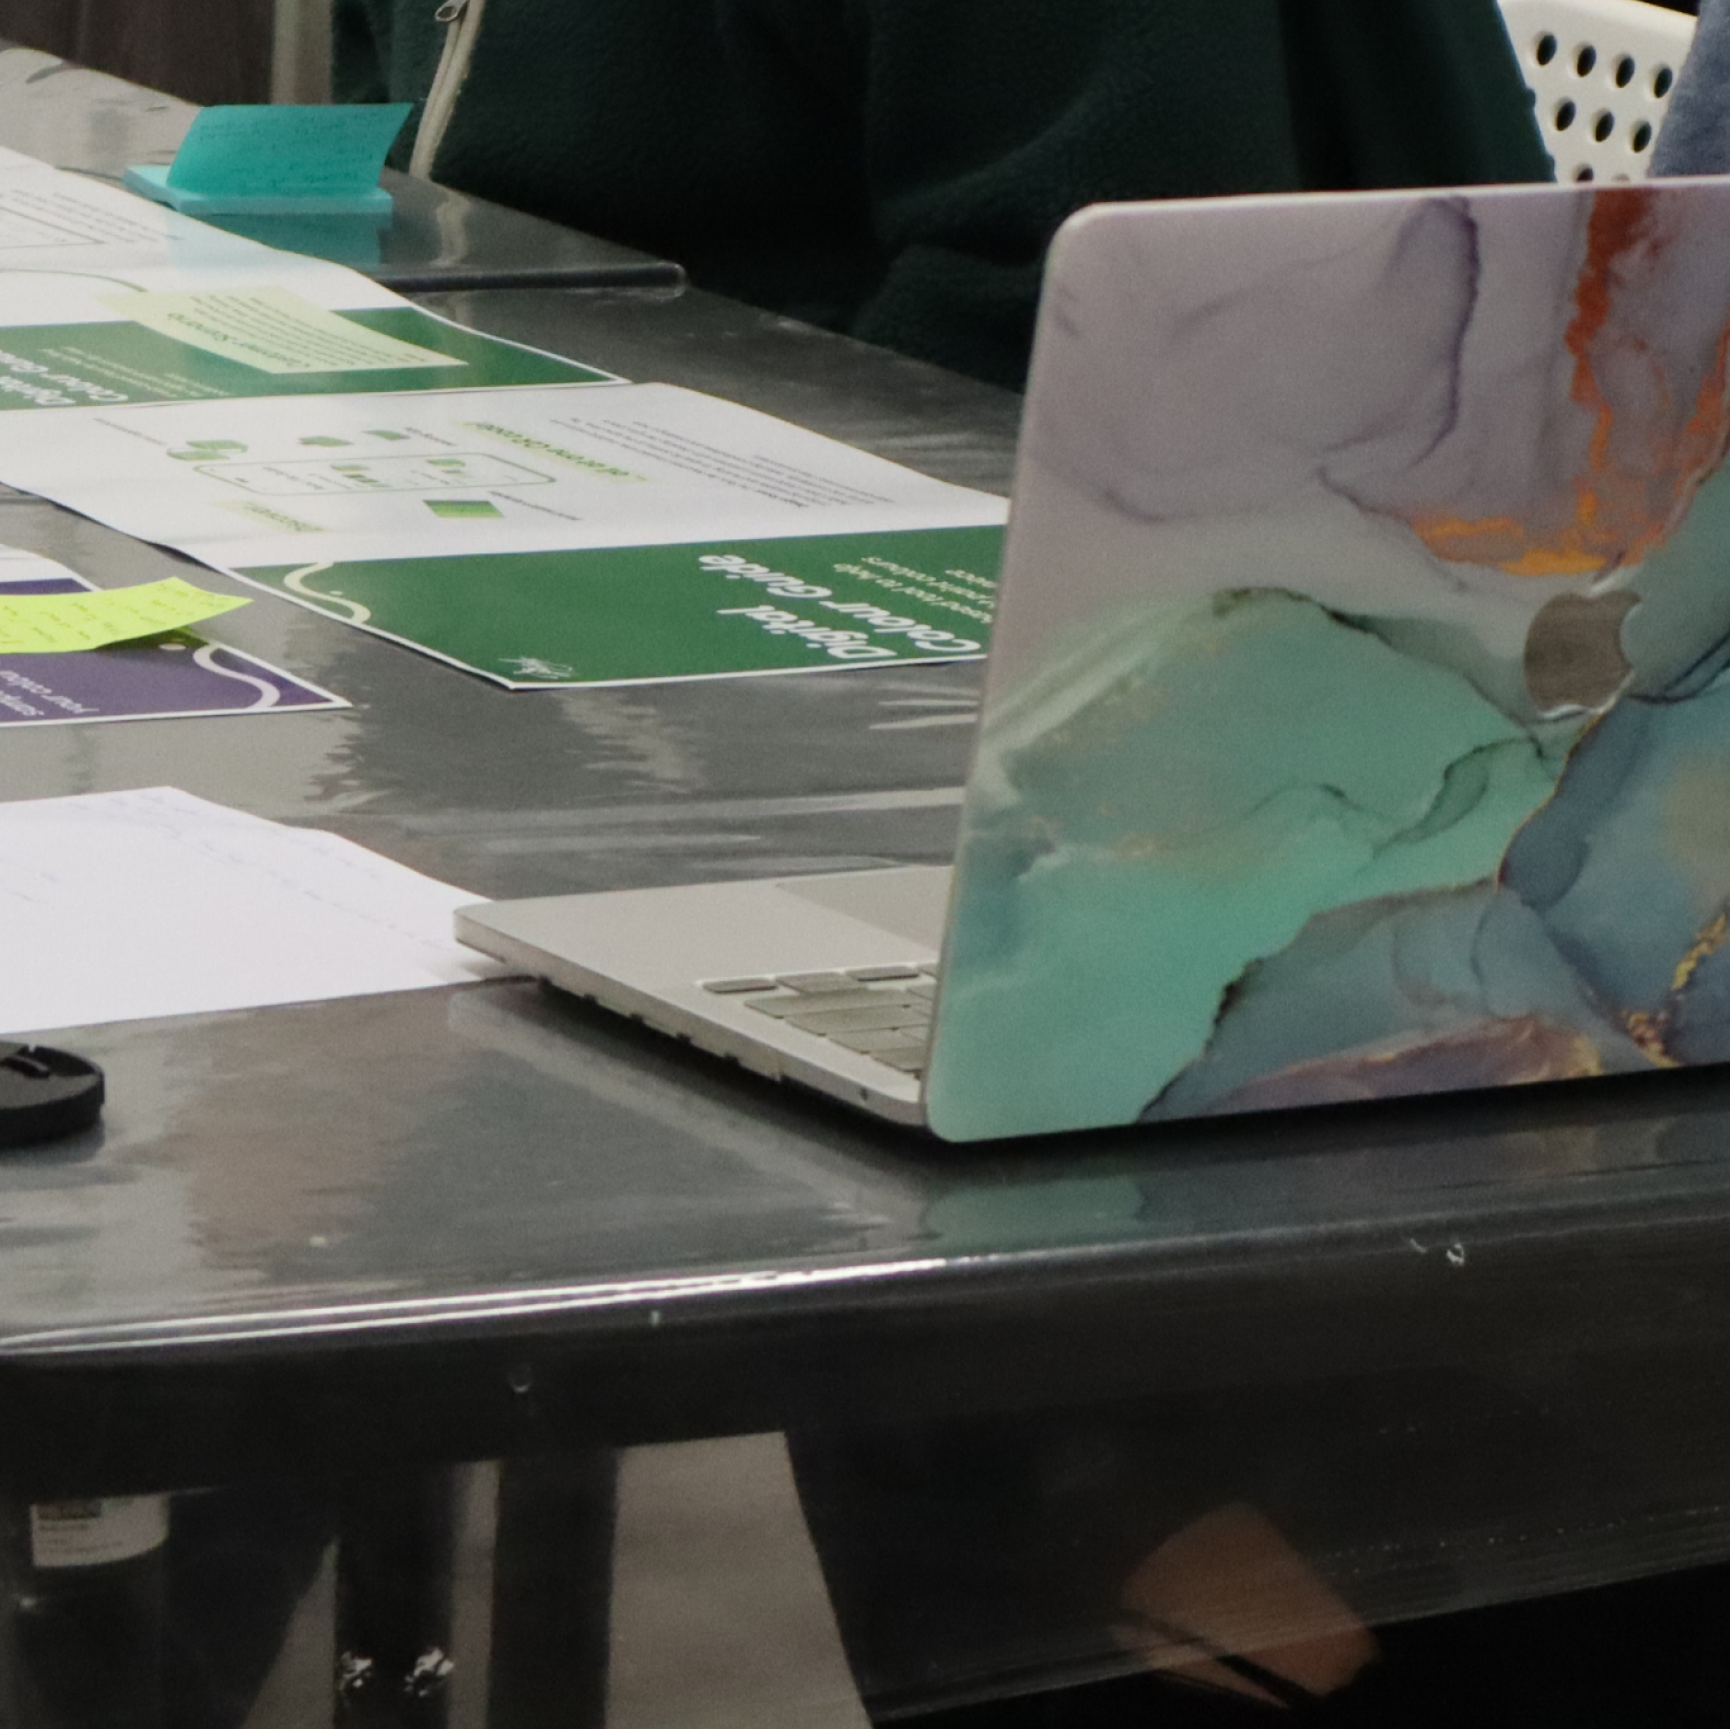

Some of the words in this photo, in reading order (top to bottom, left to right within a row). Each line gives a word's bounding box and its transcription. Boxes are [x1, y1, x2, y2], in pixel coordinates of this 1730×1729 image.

[41, 373, 129, 402] Colour
[698, 554, 833, 599] Guide
[833, 563, 882, 580] help
[860, 556, 937, 582] colours
[875, 578, 903, 588] to
[890, 586, 945, 603] tool
[927, 581, 993, 601] paint
[716, 605, 898, 660] Digital
[819, 601, 982, 652] Colour
[41, 692, 100, 714] your
